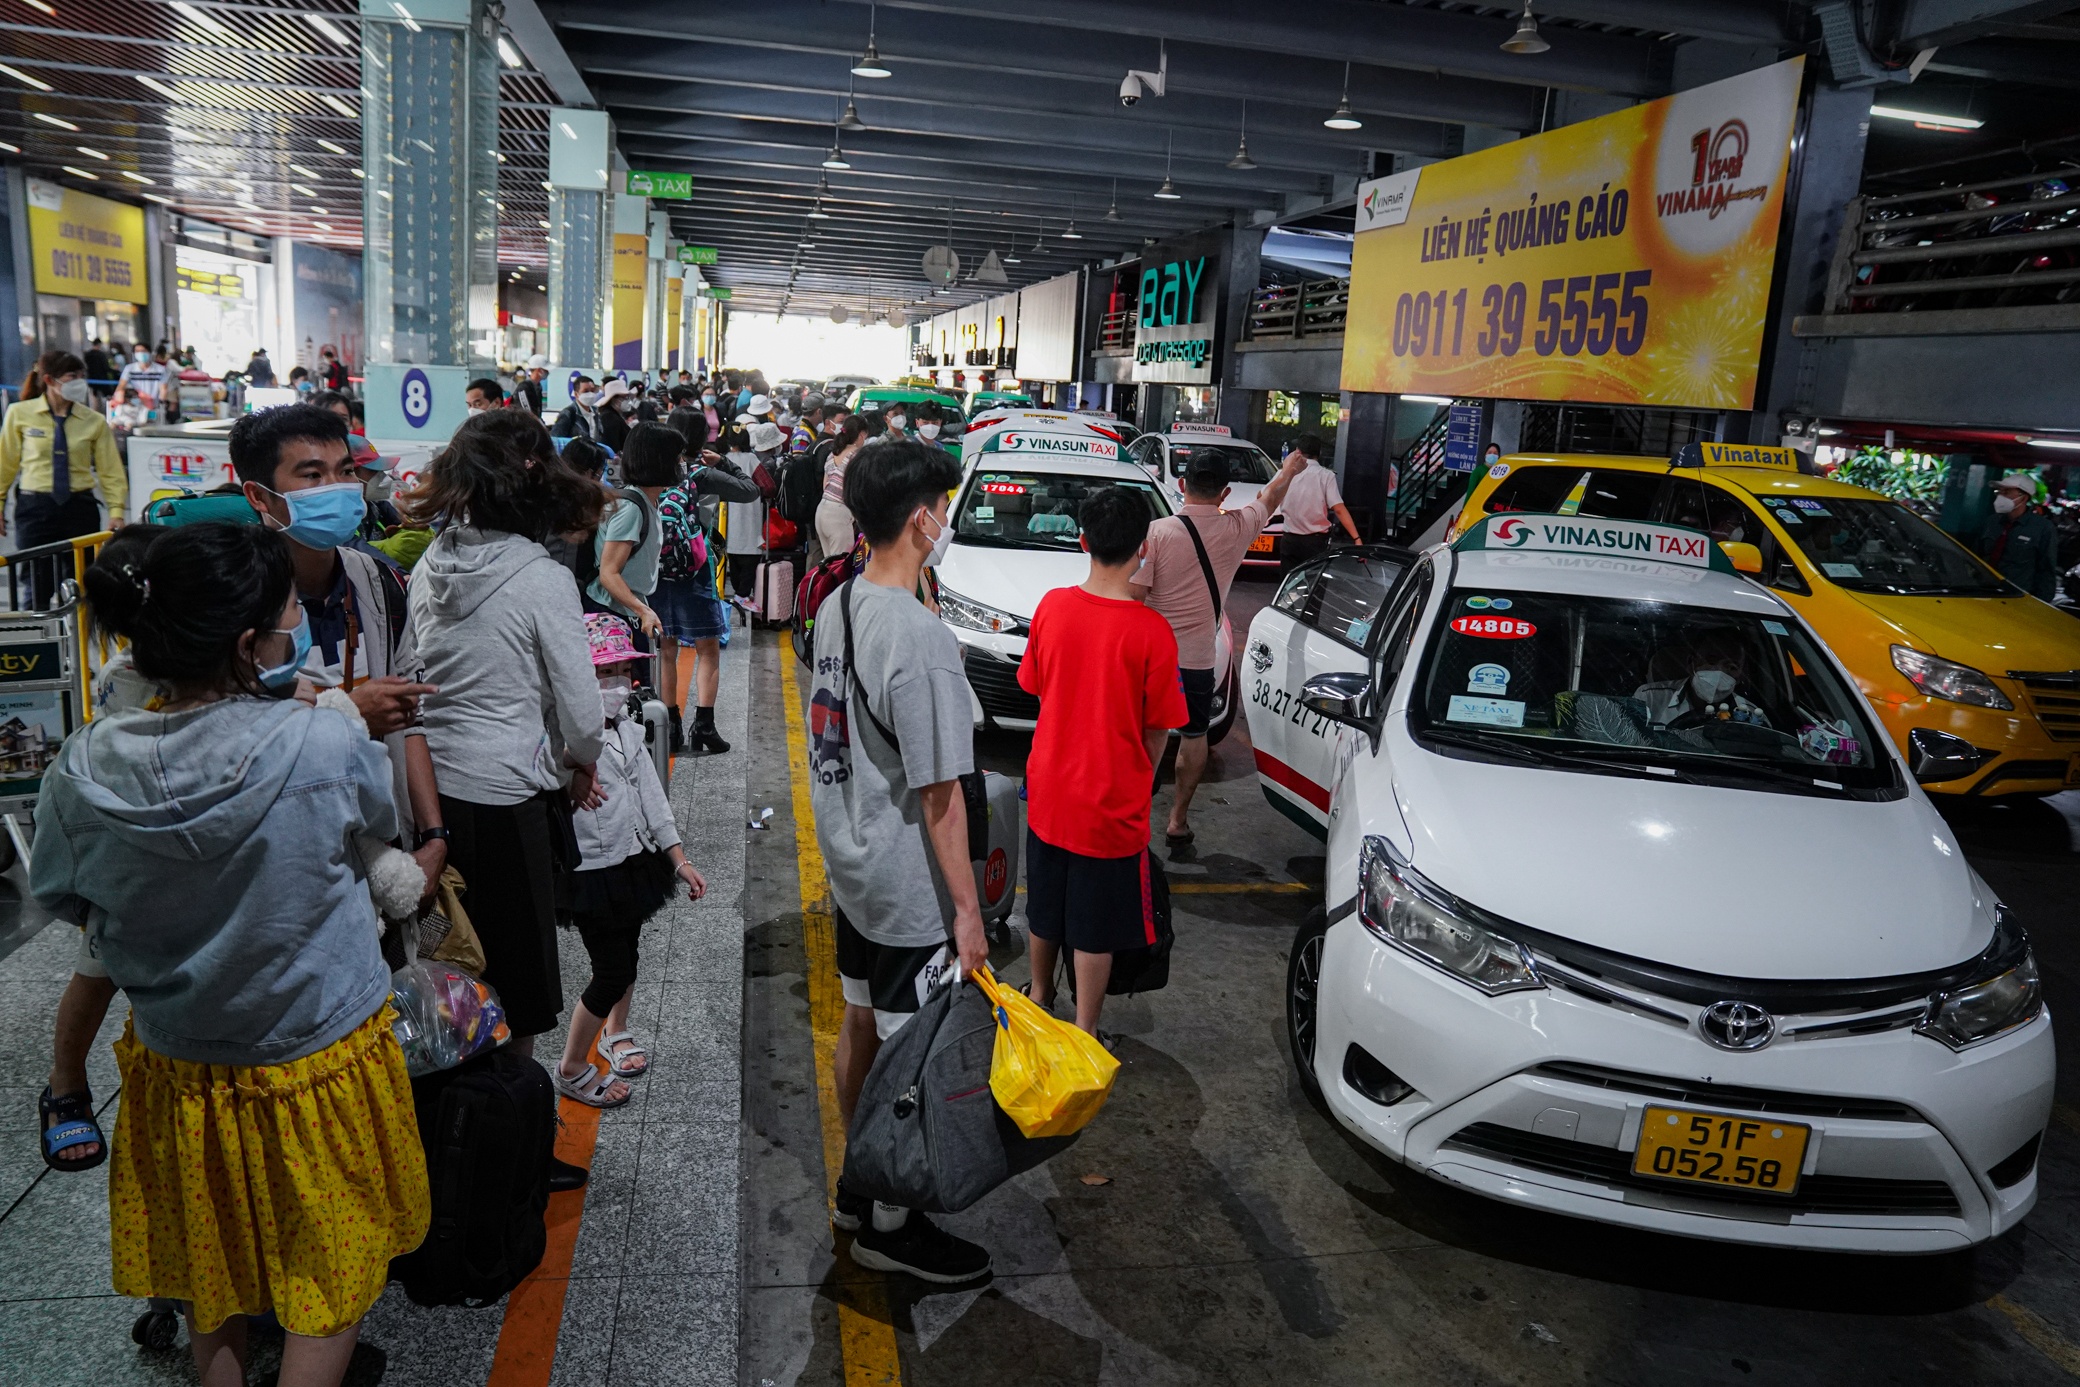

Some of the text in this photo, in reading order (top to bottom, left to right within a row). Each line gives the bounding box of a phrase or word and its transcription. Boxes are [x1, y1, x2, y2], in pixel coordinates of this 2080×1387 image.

[656, 178, 690, 193] TAXI
[1376, 192, 1404, 208] VINAMA
[1657, 183, 1727, 217] VINAMA
[1421, 182, 1629, 264] LIÊN HỆ QUẢNG CÁO
[52, 248, 83, 279] 0911
[696, 251, 716, 260] TAXI
[1392, 269, 1653, 357] 0911 39 5555
[1159, 339, 1205, 368] massage
[405, 379, 430, 418] 8
[1185, 424, 1229, 434] VINASUN TAXI
[1029, 438, 1116, 456] VINASUN TAXI
[1710, 445, 1790, 465] Vinataxi
[1491, 465, 1509, 477] 6019
[1793, 499, 1821, 510] 6019
[1249, 543, 1270, 551] 94.72
[1254, 536, 1266, 544] 1G
[1543, 524, 1706, 558] VINASUN TAXI
[1458, 619, 1530, 635] 14805
[9, 701, 33, 709] MINH
[1252, 678, 1292, 717] 38.27
[1291, 698, 1310, 728] 27
[1463, 703, 1511, 714] XE TAXI
[60, 1126, 88, 1139] SPORT
[1688, 1116, 1761, 1150] 51F
[1653, 1145, 1782, 1188] 052.58
